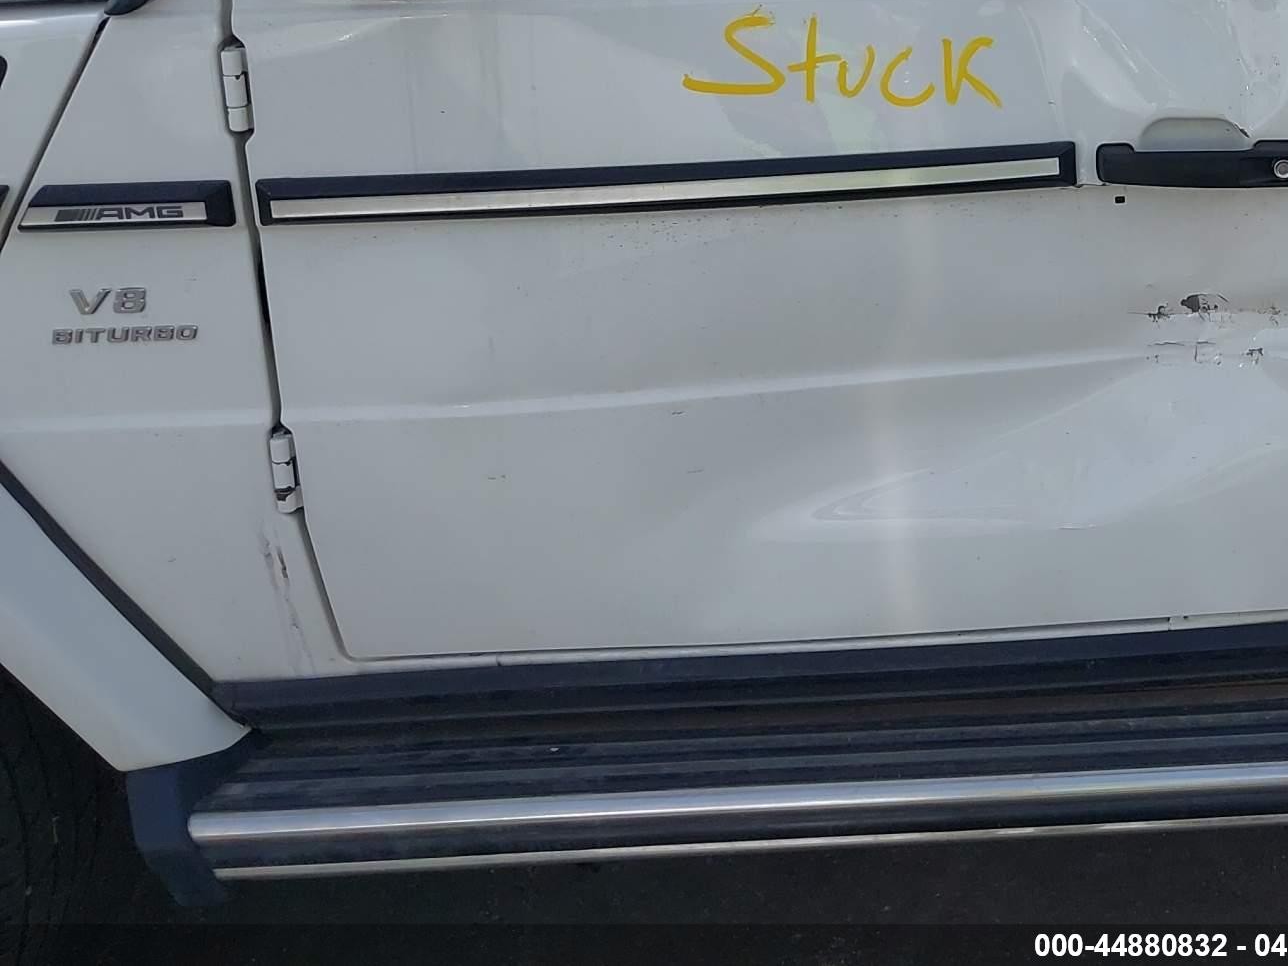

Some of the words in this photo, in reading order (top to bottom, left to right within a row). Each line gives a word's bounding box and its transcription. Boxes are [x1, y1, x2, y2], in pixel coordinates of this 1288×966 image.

[95, 205, 184, 221] AMG
[69, 286, 147, 316] V8
[51, 324, 199, 345] BITURBO
